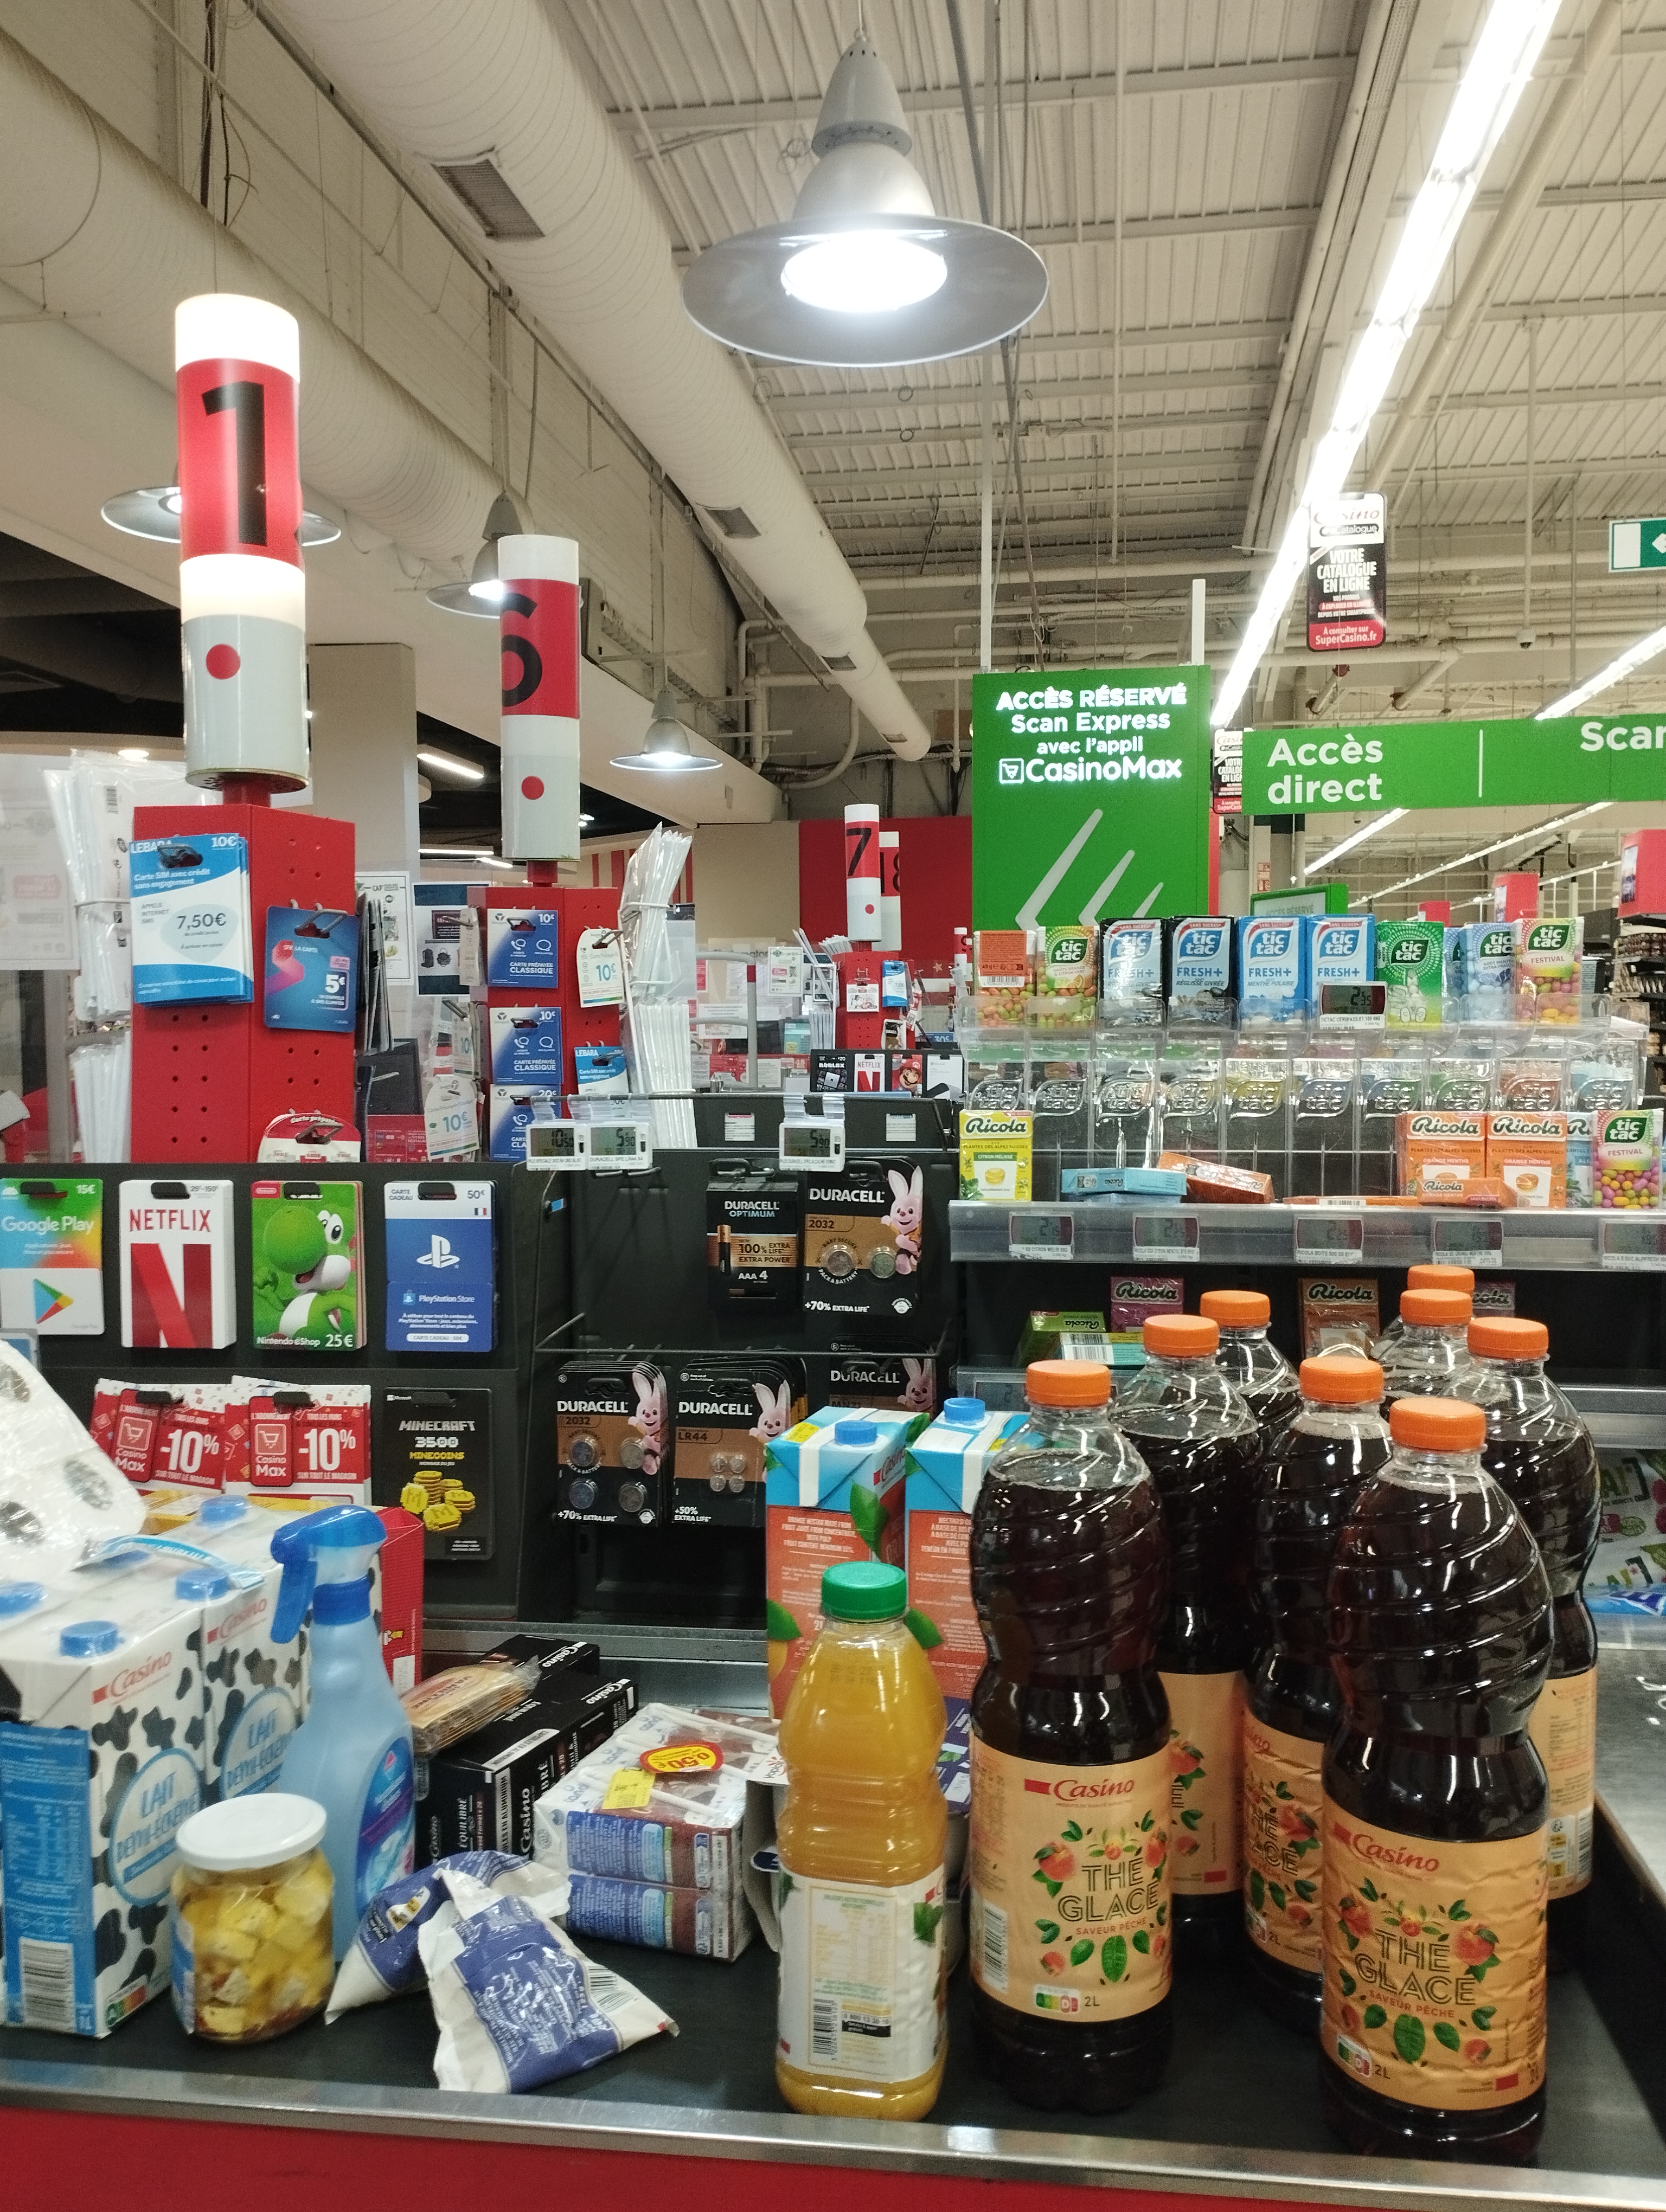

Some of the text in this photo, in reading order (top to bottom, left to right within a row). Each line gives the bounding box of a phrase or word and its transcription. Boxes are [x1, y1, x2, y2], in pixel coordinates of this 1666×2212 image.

[201, 381, 267, 546] 1
[1329, 548, 1366, 564] VOTRE
[1317, 561, 1377, 579] CATALOGUE
[1323, 576, 1370, 593] EN LIGNE
[1329, 626, 1357, 635] consulter
[1316, 631, 1377, 646] SuperCasino.fr
[996, 682, 1187, 711] ACCÈS RÉSERVÉ
[1011, 712, 1170, 734] Scan Express
[1037, 741, 1081, 755] avec
[1267, 734, 1383, 768] Accès
[1026, 756, 1182, 782] CasinoMax
[1268, 774, 1382, 805] direct
[211, 836, 238, 847] 10€
[846, 828, 872, 877] 7
[152, 878, 195, 889] engagement
[176, 913, 227, 930] 7,50€
[538, 914, 555, 923] 10€
[1193, 932, 1215, 944] tic
[1262, 932, 1285, 944] tic
[1331, 931, 1353, 944] tic
[1540, 926, 1564, 938] tic
[1123, 933, 1148, 946] tic
[1533, 936, 1562, 948] tac
[1061, 941, 1082, 952] tic
[1116, 944, 1146, 956] tac
[1186, 942, 1214, 954] tac
[1255, 942, 1284, 955] tac
[1325, 942, 1353, 955] tac
[1401, 941, 1422, 952] tic
[1055, 950, 1081, 961] tac
[1395, 949, 1421, 961] tac
[1531, 956, 1565, 964] FESTIVAL
[1108, 968, 1155, 978] FRSH+
[965, 1117, 1027, 1133] Ricola
[1412, 1116, 1479, 1134] Ricola
[1493, 1115, 1561, 1135] Ricola
[1616, 1118, 1642, 1131] tic
[1609, 1128, 1639, 1140] tac
[76, 1185, 95, 1194] 15€
[1423, 1180, 1463, 1192] Ricola
[467, 1190, 485, 1199] 50€
[810, 1188, 885, 1203] DURACELL
[725, 1201, 779, 1210] DURACELL
[2, 1216, 94, 1236] Google Play
[130, 1209, 212, 1233] NETFLIX
[809, 1220, 835, 1229] 2032
[739, 1243, 767, 1253] 100%
[759, 1270, 768, 1279] 4
[1115, 1281, 1178, 1300] Ricola
[1309, 1283, 1373, 1301] Ricola
[1473, 1290, 1509, 1304] cola
[419, 1295, 457, 1304] PlayStation
[804, 1301, 831, 1311] +70%
[1065, 1320, 1100, 1329] Ricola
[256, 1334, 354, 1348] Nintendo eShop 25€
[830, 1369, 900, 1384] DURACELL
[557, 1401, 629, 1413] DURACELL
[678, 1401, 753, 1416] DURACELL
[399, 1420, 476, 1431] MINECRAFT
[566, 1417, 591, 1425] 2032
[415, 1437, 459, 1448] 3500
[678, 1432, 708, 1441] LR44
[116, 1448, 147, 1460] Casino
[160, 1429, 220, 1473] -10%
[298, 1428, 356, 1471] -10%
[114, 1456, 145, 1472] Max
[255, 1456, 287, 1464] Casino
[255, 1464, 286, 1476] Max
[558, 1510, 582, 1520] +70%
[675, 1507, 699, 1515] +50%
[219, 1597, 267, 1639] Casino
[542, 1646, 579, 1668] Casino
[110, 1650, 172, 1698] Casino
[586, 1682, 623, 1705] Casino
[142, 1771, 177, 1818] LAIT
[1053, 1778, 1135, 1801] Casino
[521, 1787, 531, 1854] Casino
[1353, 1832, 1440, 1873] Casino
[1075, 1917, 1147, 1935] SAVEUR PÊCHE
[1084, 1996, 1100, 2007] 2L
[1368, 1989, 1455, 2019] SAVEUR PÊCHE
[1374, 2063, 1391, 2080] 2L
